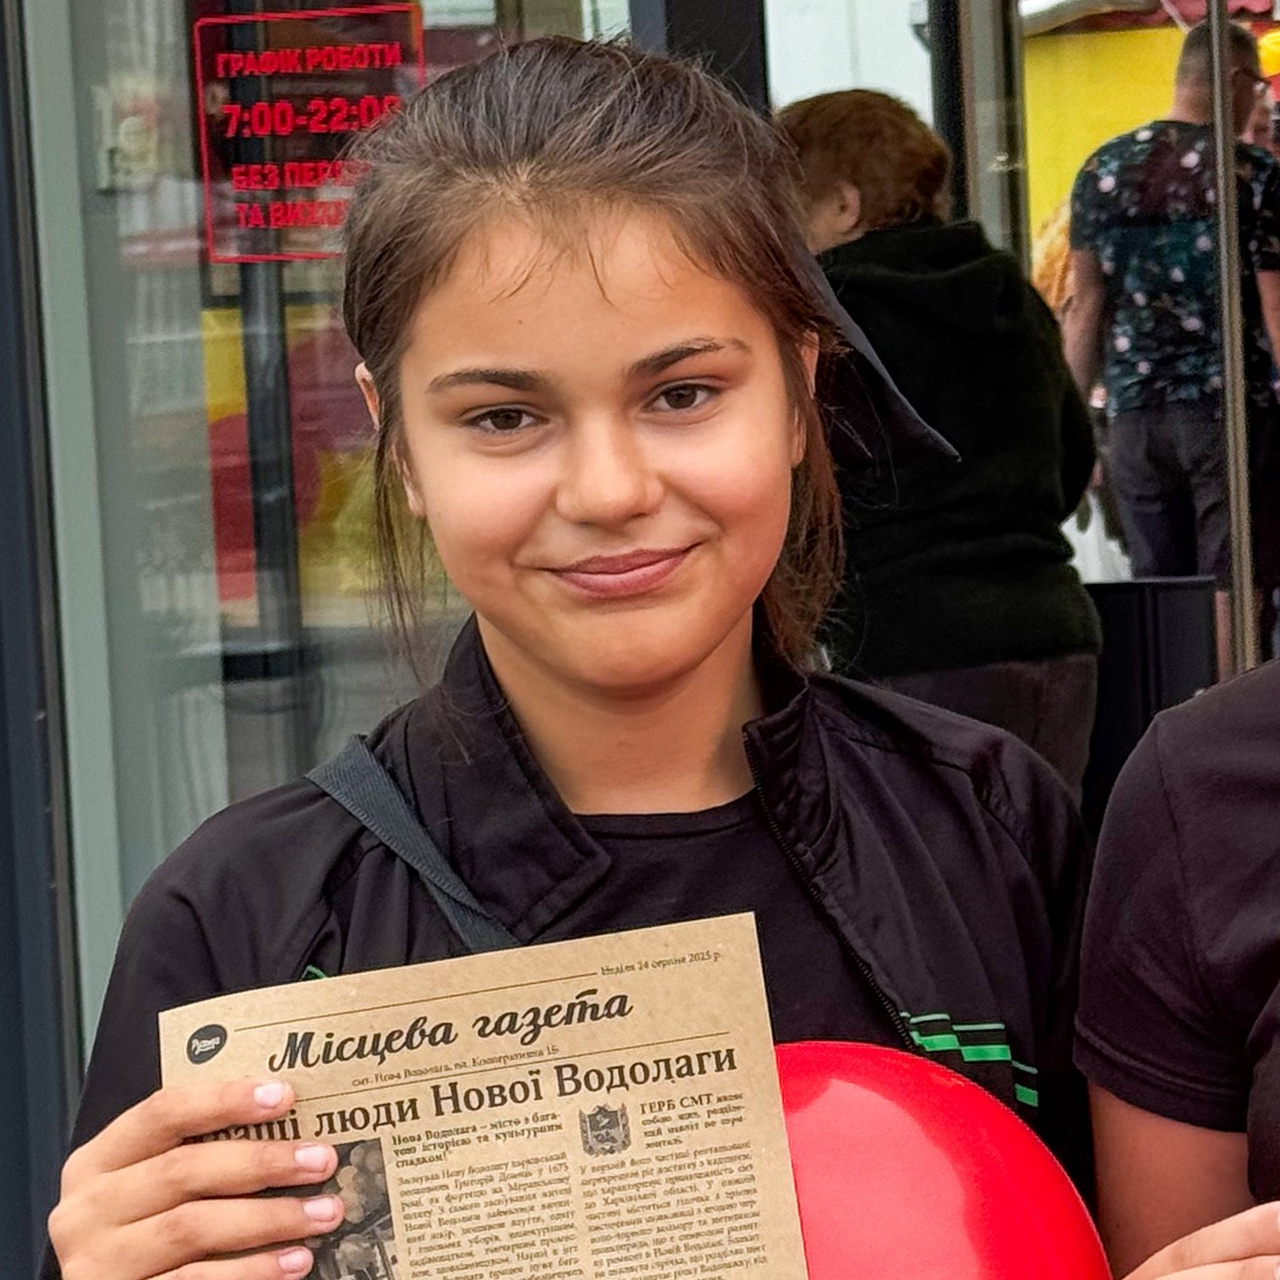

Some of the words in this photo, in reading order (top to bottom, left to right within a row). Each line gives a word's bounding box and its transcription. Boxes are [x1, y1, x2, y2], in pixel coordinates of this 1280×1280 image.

[216, 48, 301, 78] ГРАФІК
[304, 42, 401, 71] РОБОТИ
[232, 164, 279, 192] БЕЗ
[234, 202, 265, 229] ТА
[269, 1016, 458, 1072] Місцева
[472, 989, 633, 1046] газета
[314, 1098, 420, 1137] люди
[430, 1069, 543, 1116] Нової
[554, 1049, 737, 1097] Водолаги
[640, 1099, 675, 1114] ГЕРБ
[680, 1093, 713, 1108] СМТ
